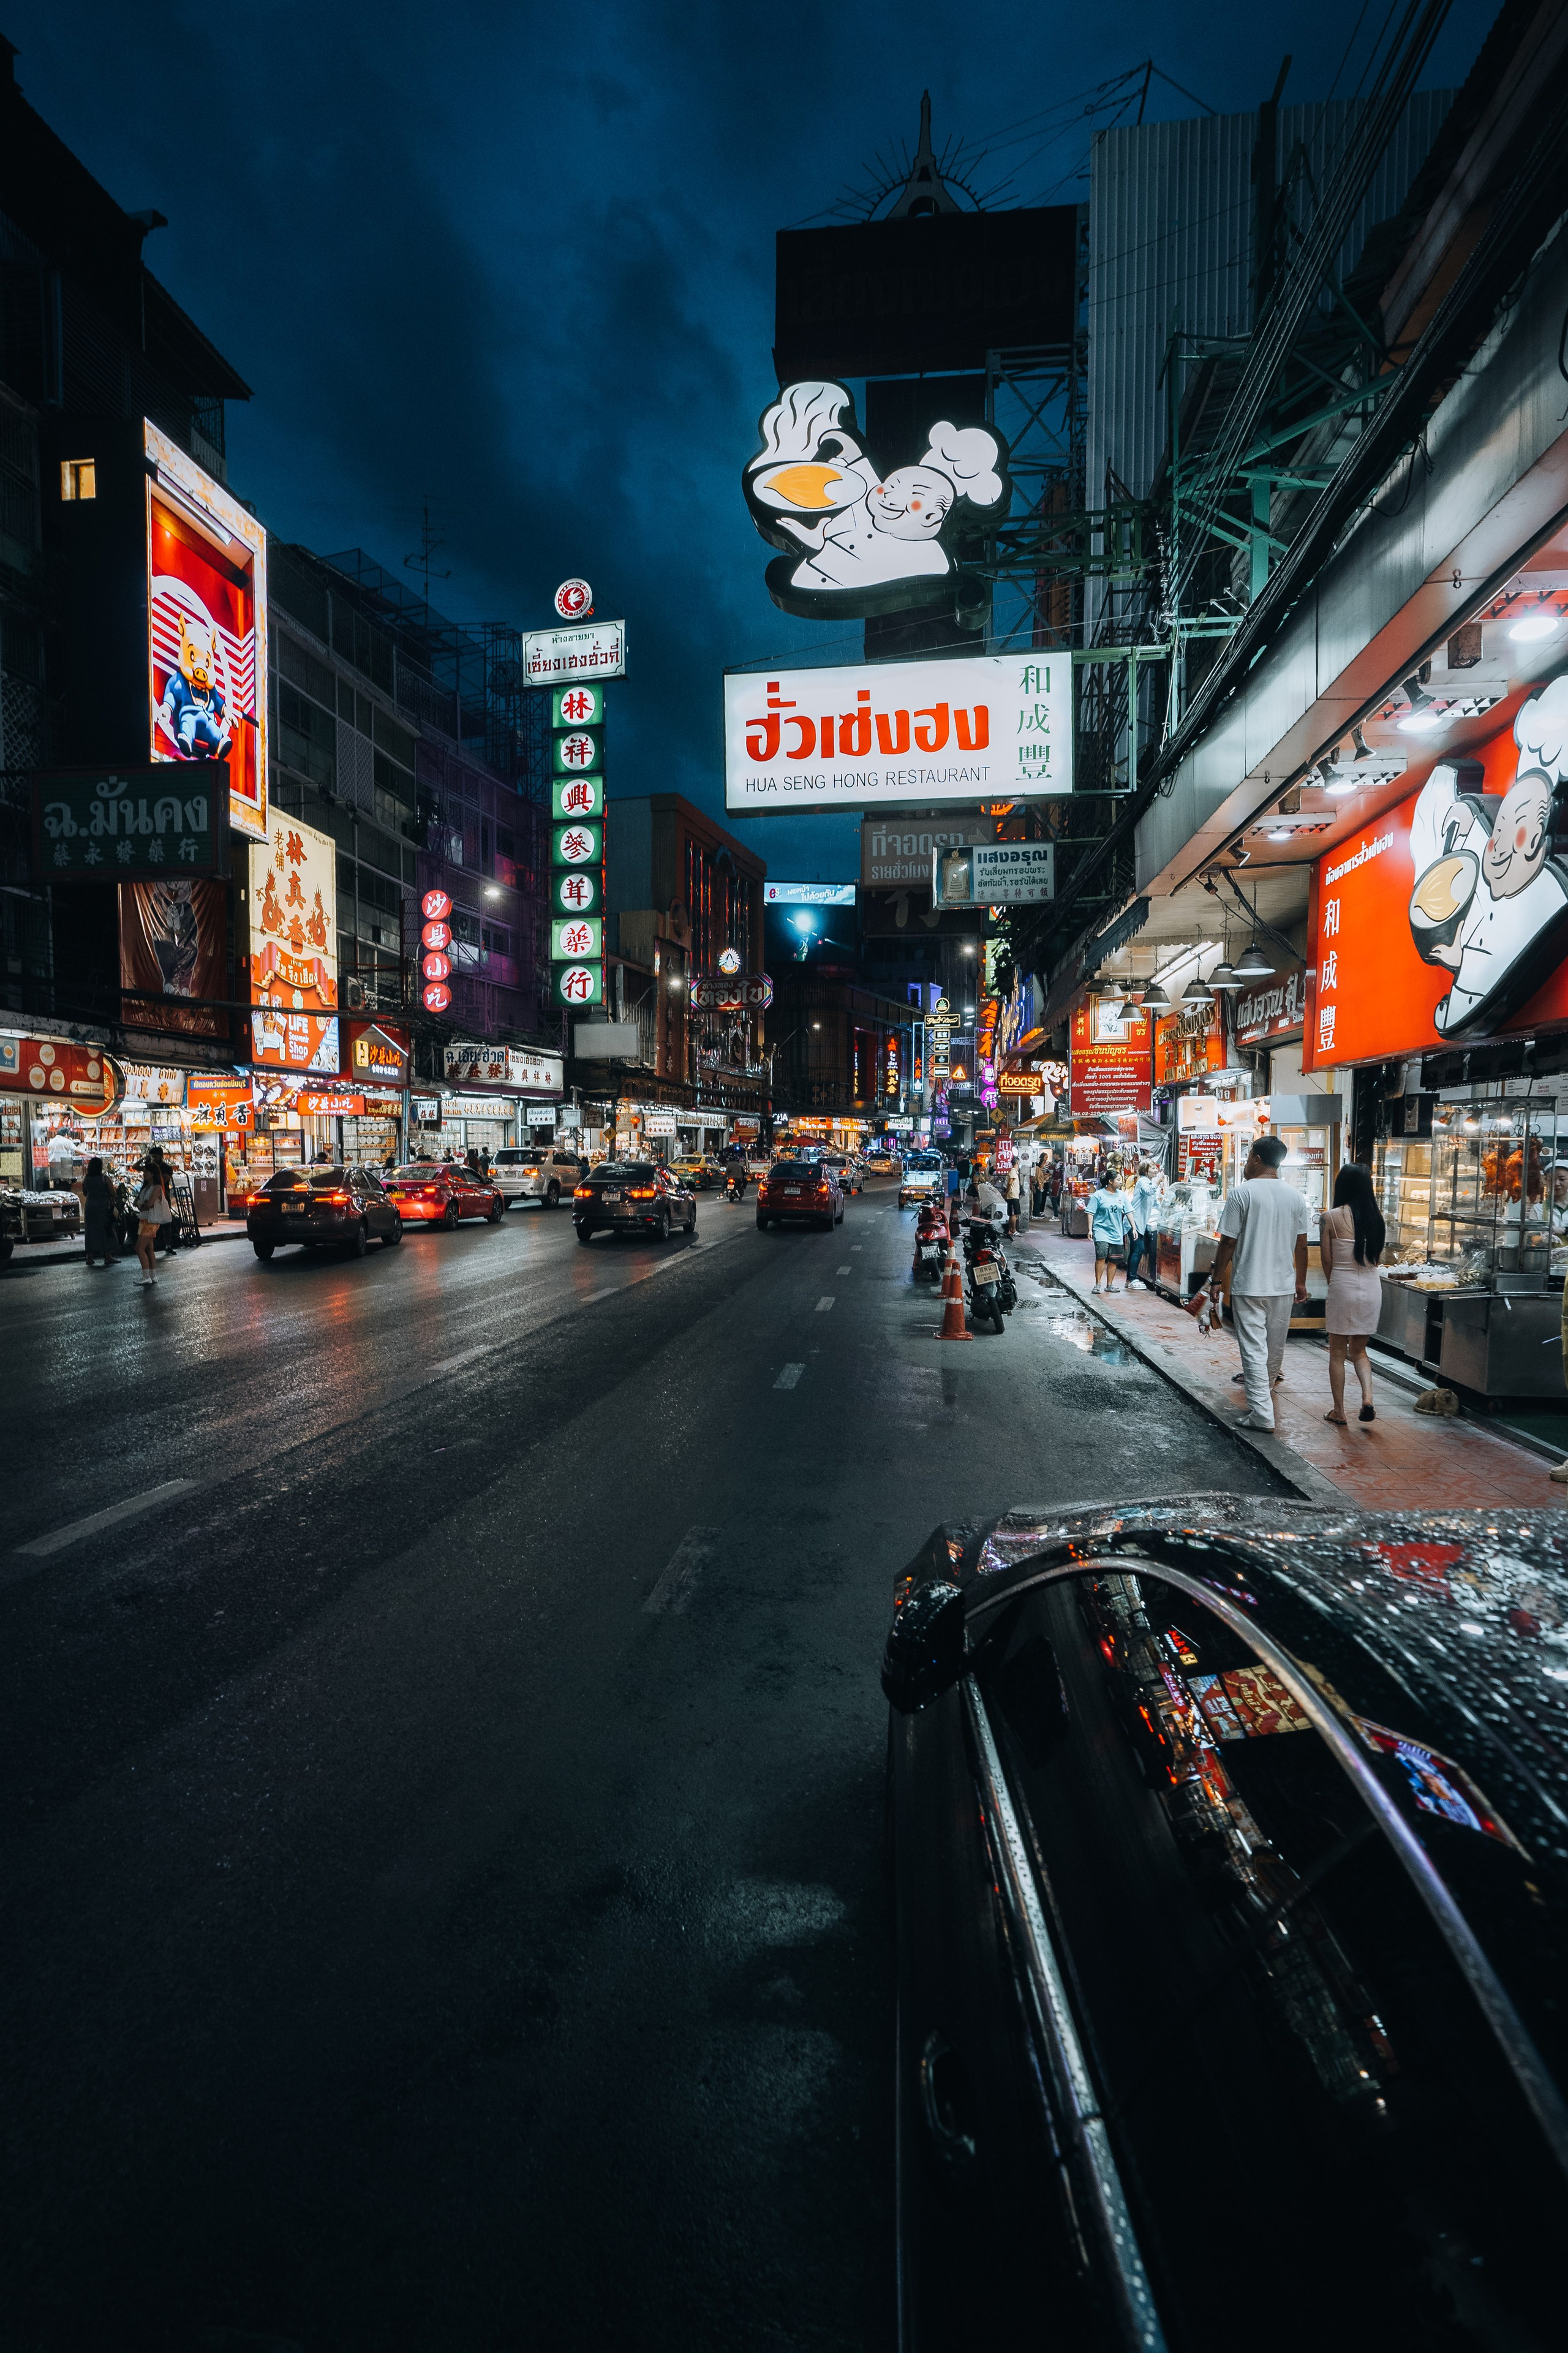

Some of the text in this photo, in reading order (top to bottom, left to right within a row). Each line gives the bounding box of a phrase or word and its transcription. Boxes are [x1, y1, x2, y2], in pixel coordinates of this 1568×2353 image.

[552, 633, 594, 644] ห้างขายยา
[745, 681, 990, 763] ฮั่วเซ่งฮง
[745, 766, 990, 793] HUA SENG HONG RESTAURANT
[43, 775, 208, 839] ฉ.มั่นคง
[978, 849, 1048, 866] แสงอรุณ
[285, 830, 308, 956] 林真香
[769, 888, 783, 899] es
[698, 980, 763, 1007] ทองใบ
[288, 1014, 309, 1034] LIFE
[288, 1032, 309, 1044] Souvenir
[288, 1041, 309, 1059] Shop
[369, 1045, 403, 1067] 沙县小吃
[1000, 1072, 1041, 1087] ที่จอดรถ
[307, 1096, 353, 1110] 沙县小吃
[1110, 1204, 1118, 1214] 32
